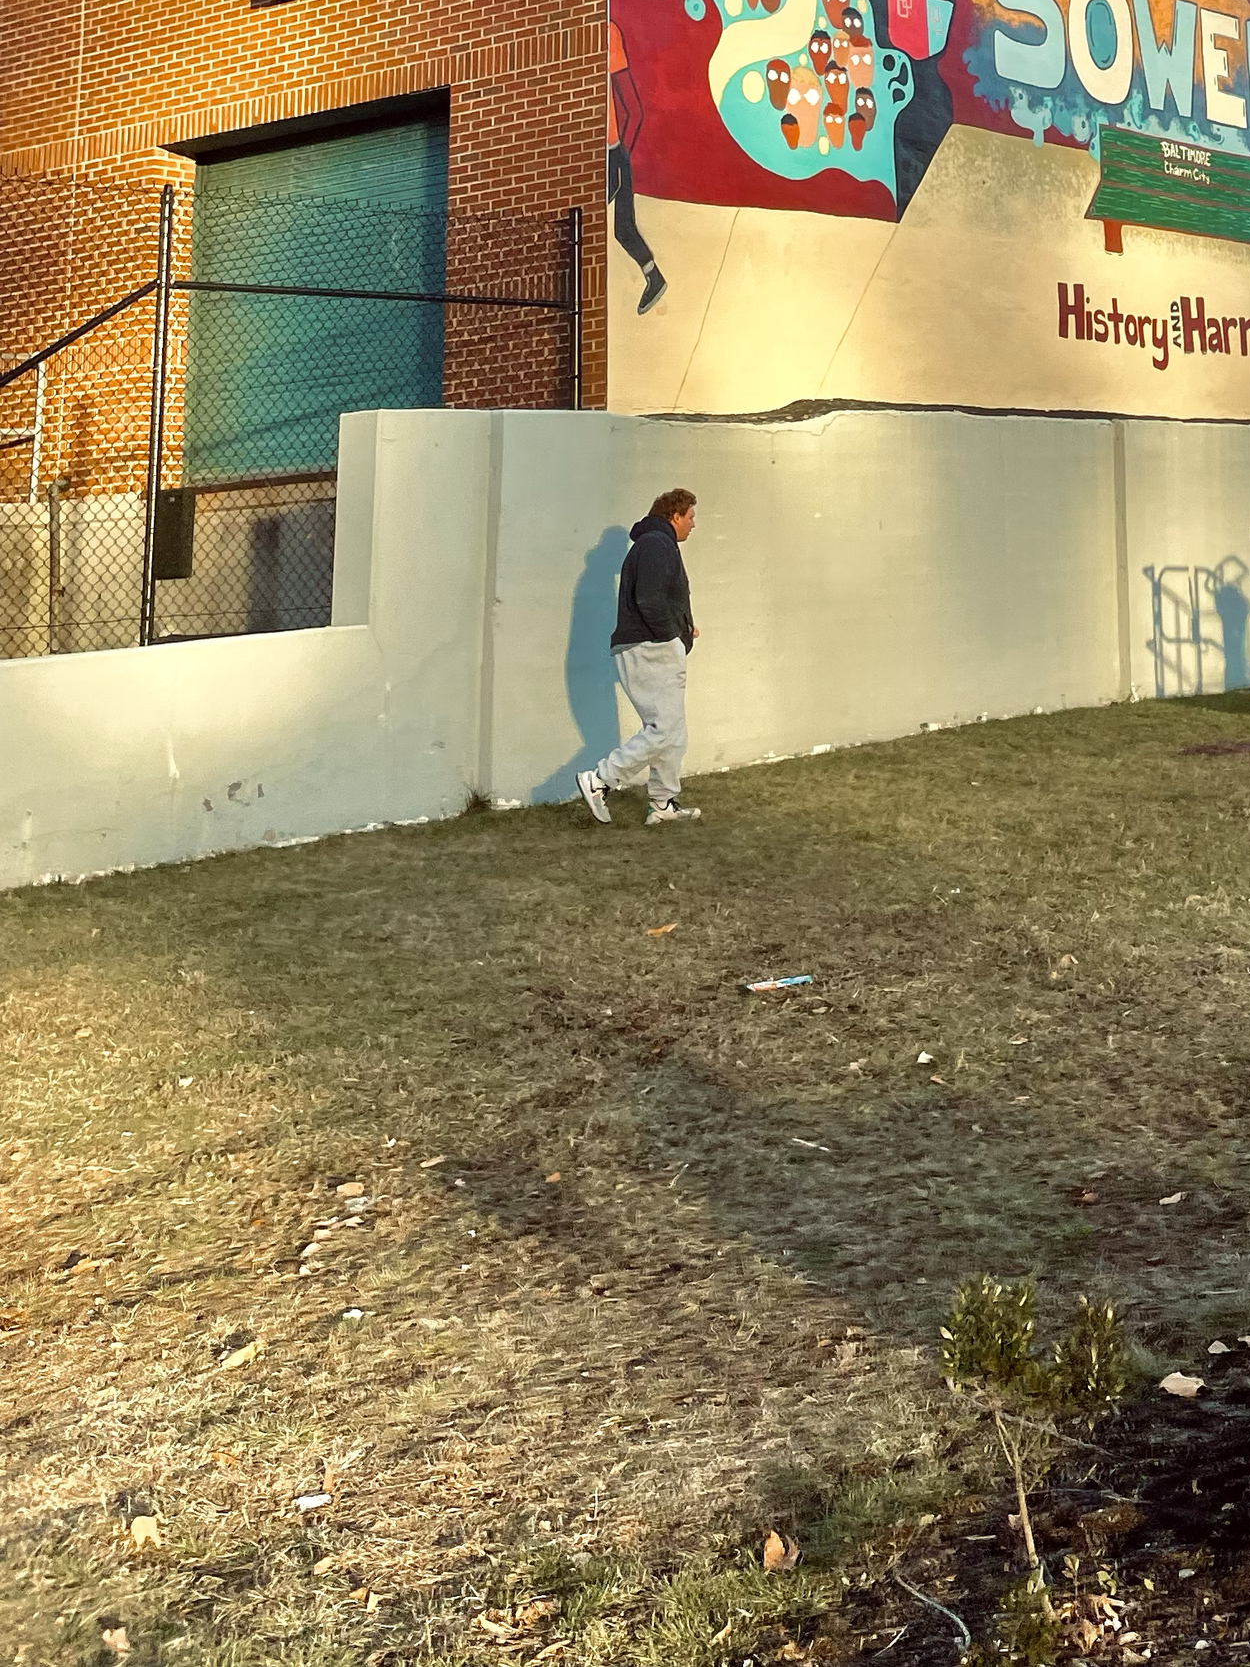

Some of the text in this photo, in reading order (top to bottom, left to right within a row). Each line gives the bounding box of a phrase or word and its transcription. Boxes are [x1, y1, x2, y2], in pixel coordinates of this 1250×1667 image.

[1160, 141, 1211, 167] BALTIMORE
[1164, 160, 1210, 185] Charm City
[1057, 282, 1169, 371] History
[1170, 300, 1183, 349] AND
